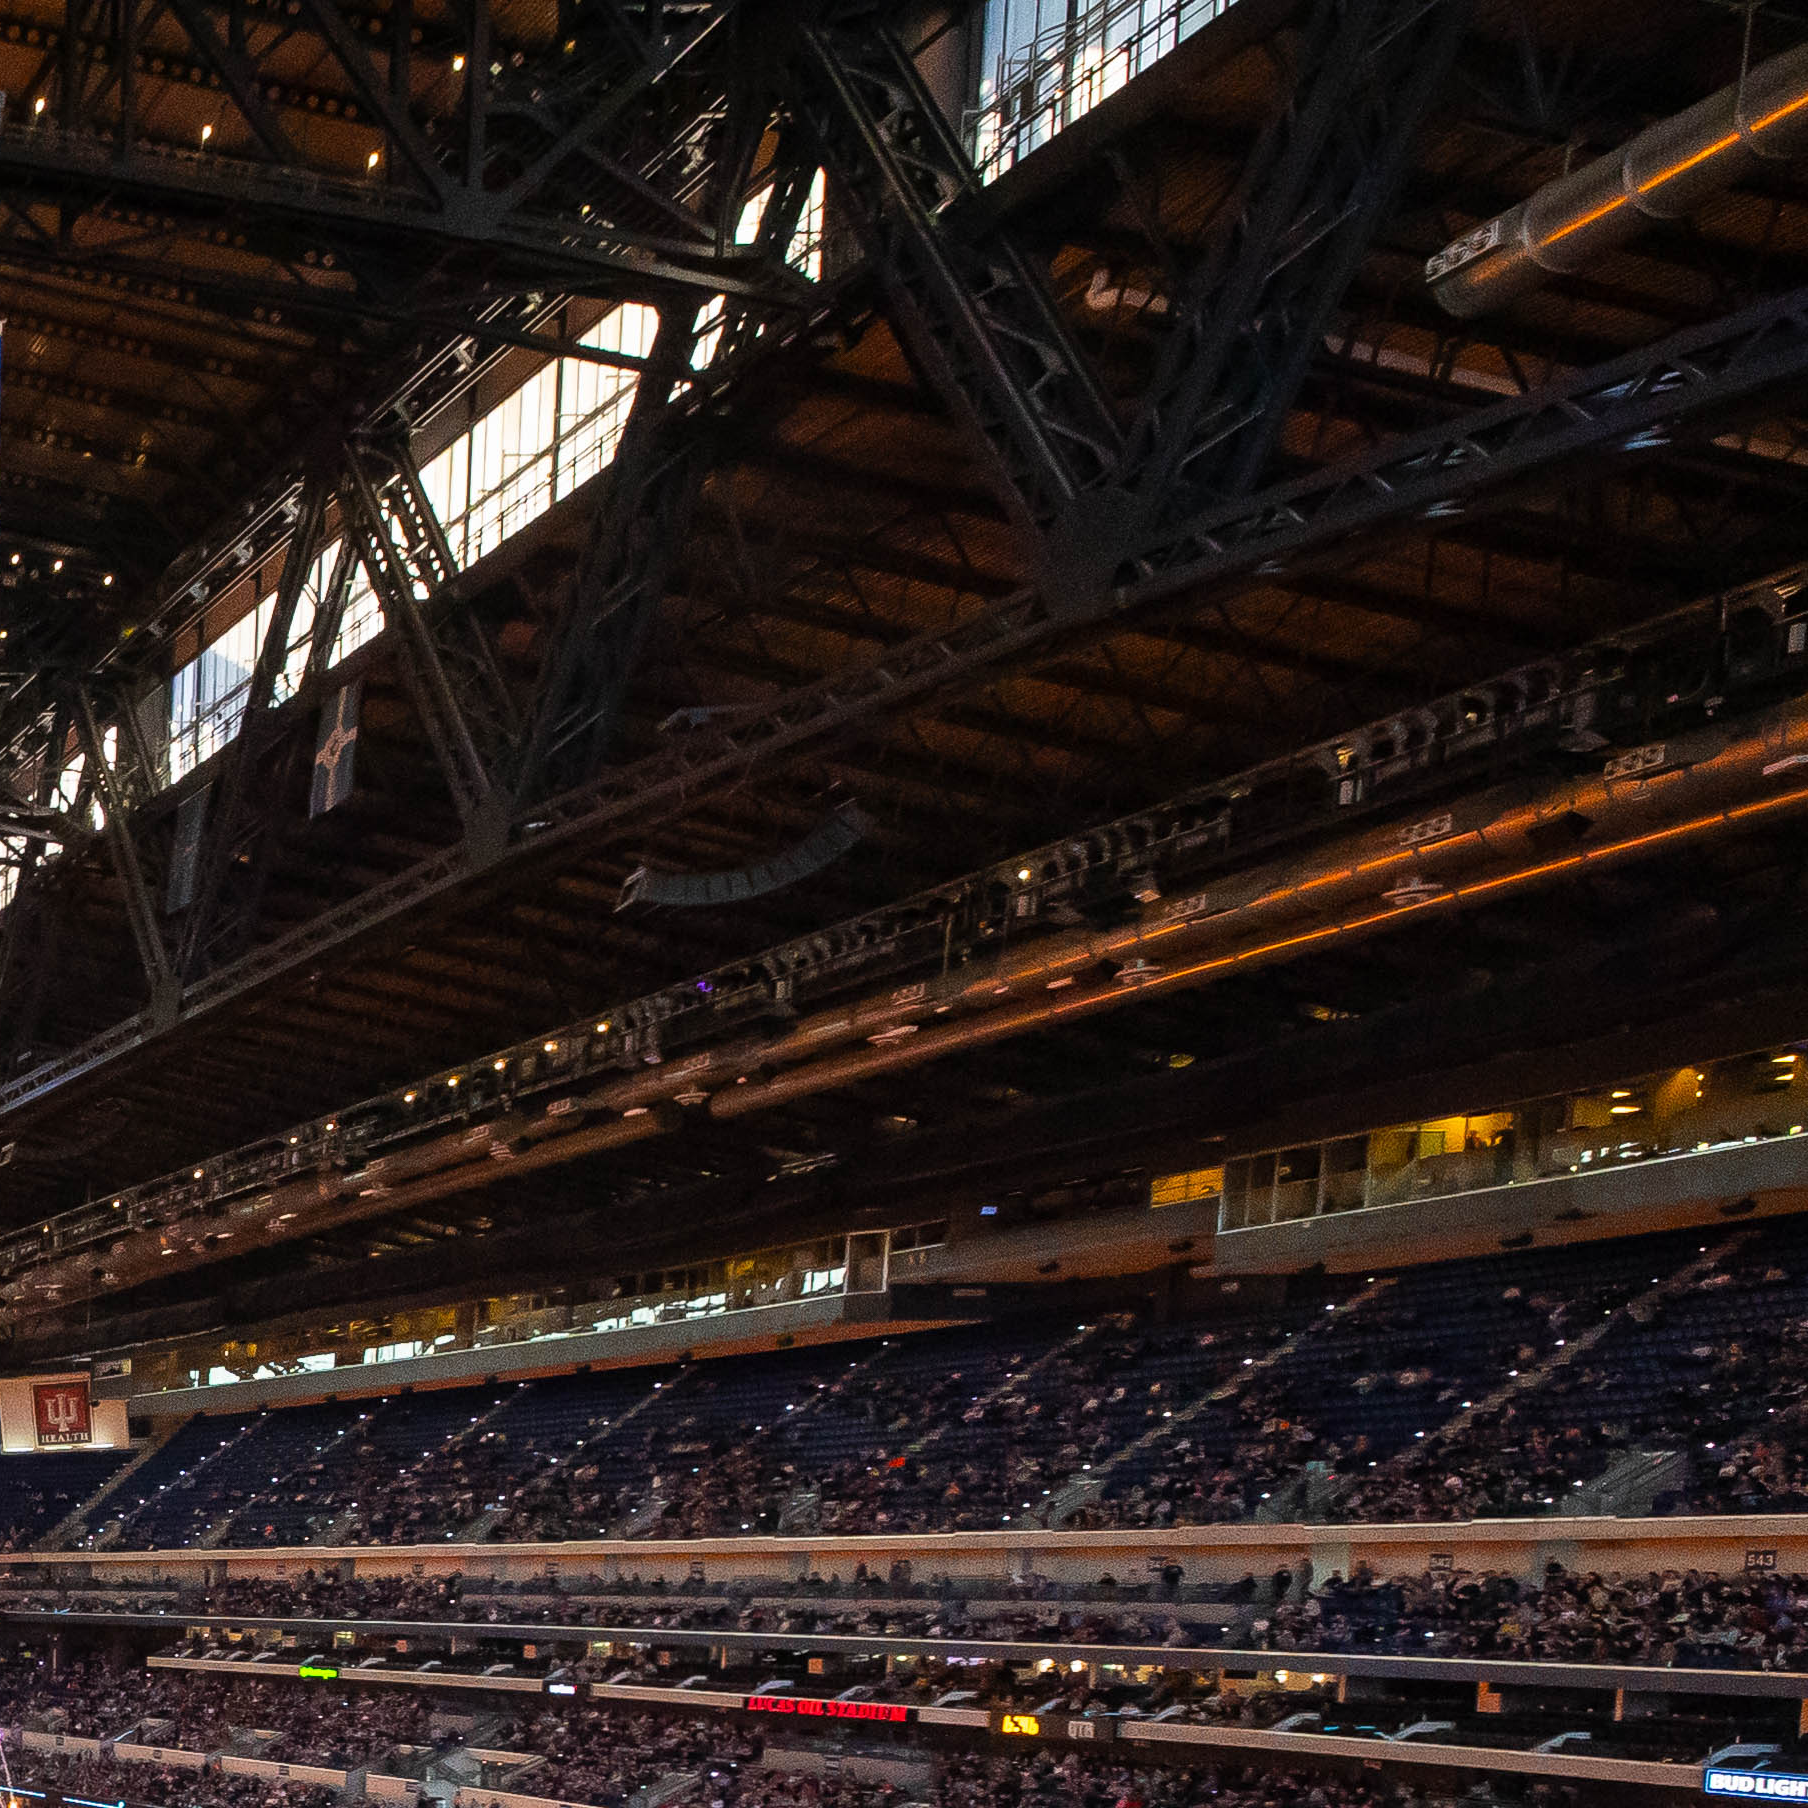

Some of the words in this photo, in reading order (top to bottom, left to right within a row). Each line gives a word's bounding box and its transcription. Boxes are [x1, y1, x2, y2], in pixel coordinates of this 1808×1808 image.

[41, 1431, 90, 1444] HEALTH
[1747, 1553, 1773, 1566] 543
[748, 1697, 795, 1713] LUCAS
[797, 1700, 824, 1716] OIL
[827, 1703, 907, 1721] STADIUM
[1710, 1774, 1754, 1791] BUD
